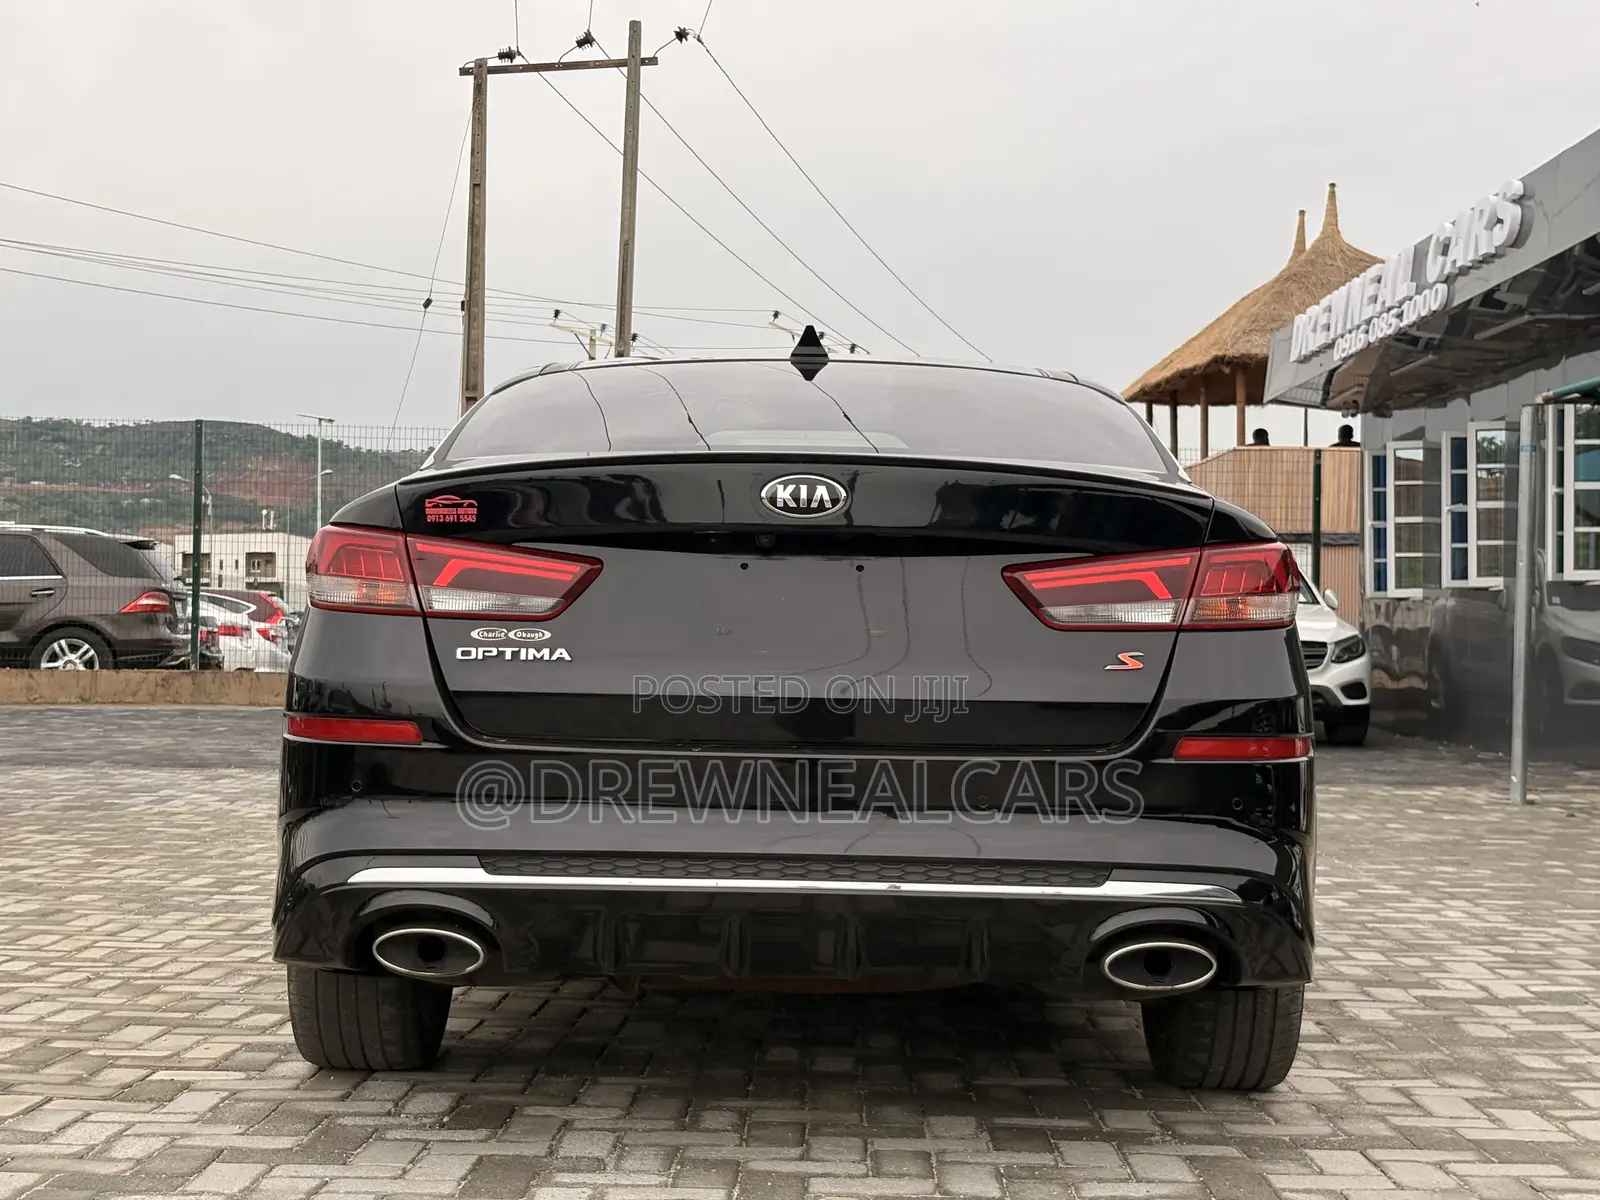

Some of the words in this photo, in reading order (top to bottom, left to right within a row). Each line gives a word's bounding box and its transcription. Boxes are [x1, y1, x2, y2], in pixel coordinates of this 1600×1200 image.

[1426, 179, 1524, 283] CARS
[1333, 325, 1368, 362] 0916
[1368, 308, 1402, 343] 085
[1400, 283, 1448, 328] 1000
[776, 484, 833, 508] KIA
[426, 514, 444, 523] 0913
[445, 514, 457, 523] 691
[459, 514, 477, 523] 5545
[478, 630, 506, 638] Charlie
[516, 630, 543, 640] Obaugh
[456, 647, 572, 661] OPTIMA
[1104, 651, 1145, 670] S
